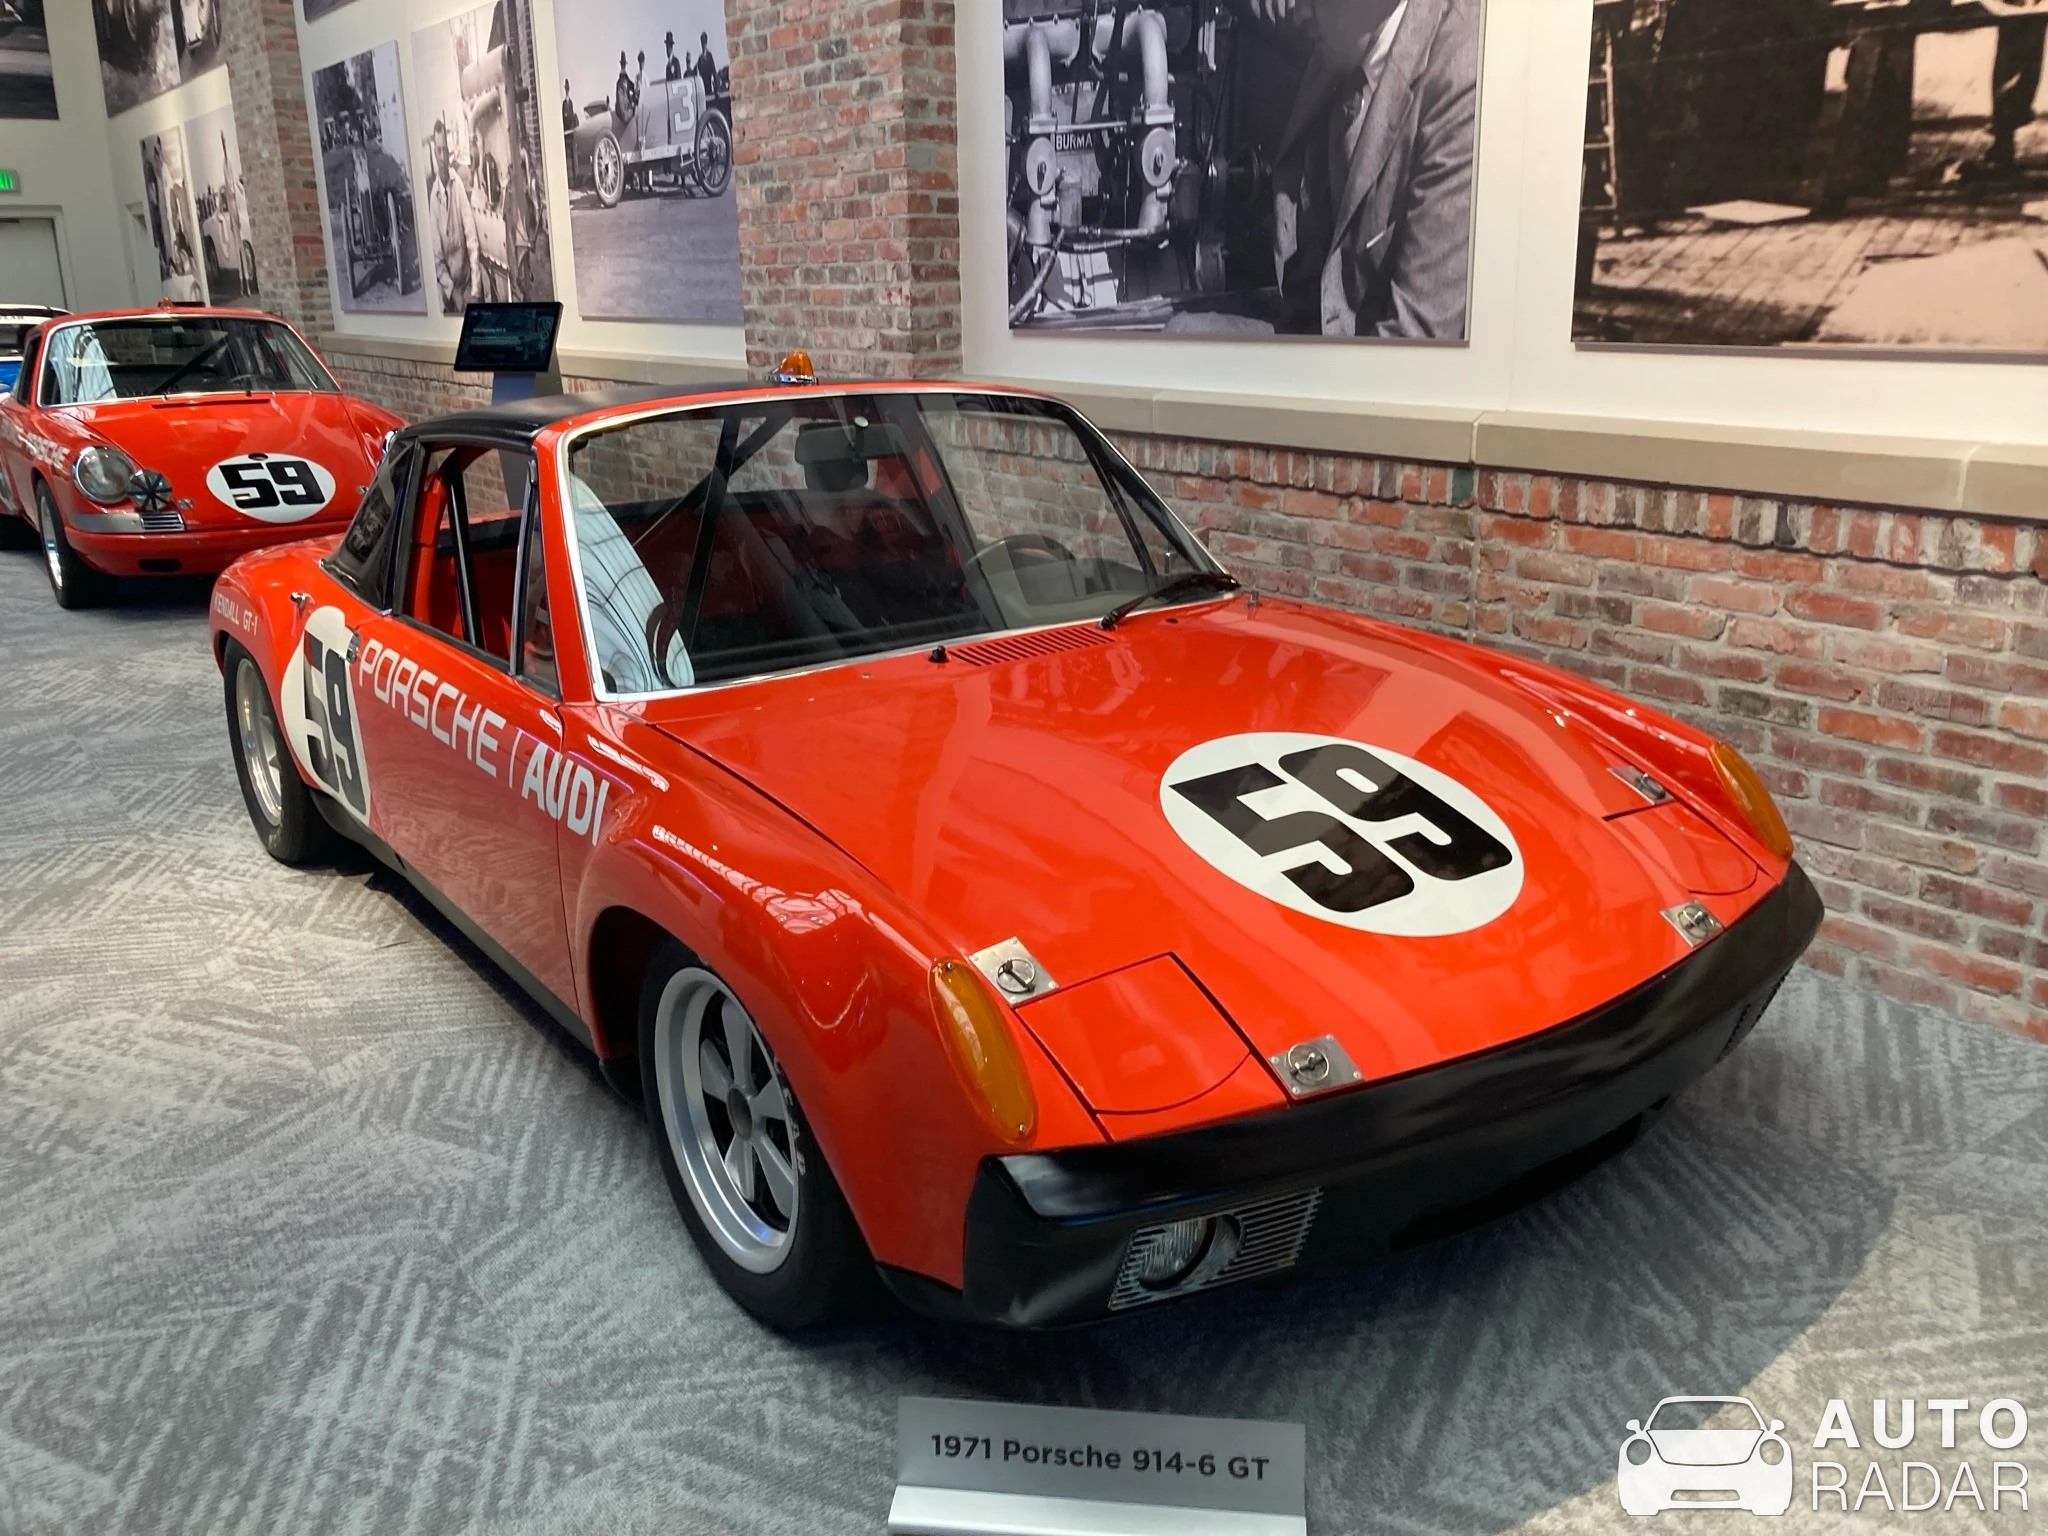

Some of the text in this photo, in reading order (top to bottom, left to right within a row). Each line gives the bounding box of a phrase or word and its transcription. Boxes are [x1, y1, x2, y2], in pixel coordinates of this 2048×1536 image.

[671, 80, 695, 133] 3
[1055, 132, 1093, 150] BURMA
[218, 461, 326, 509] 59
[303, 628, 367, 816] 59
[359, 638, 507, 778] PORSCHE
[521, 741, 609, 847] AUDI
[1168, 744, 1513, 913] 59
[931, 1434, 1270, 1480] 1971 Porsche 914-6 GT
